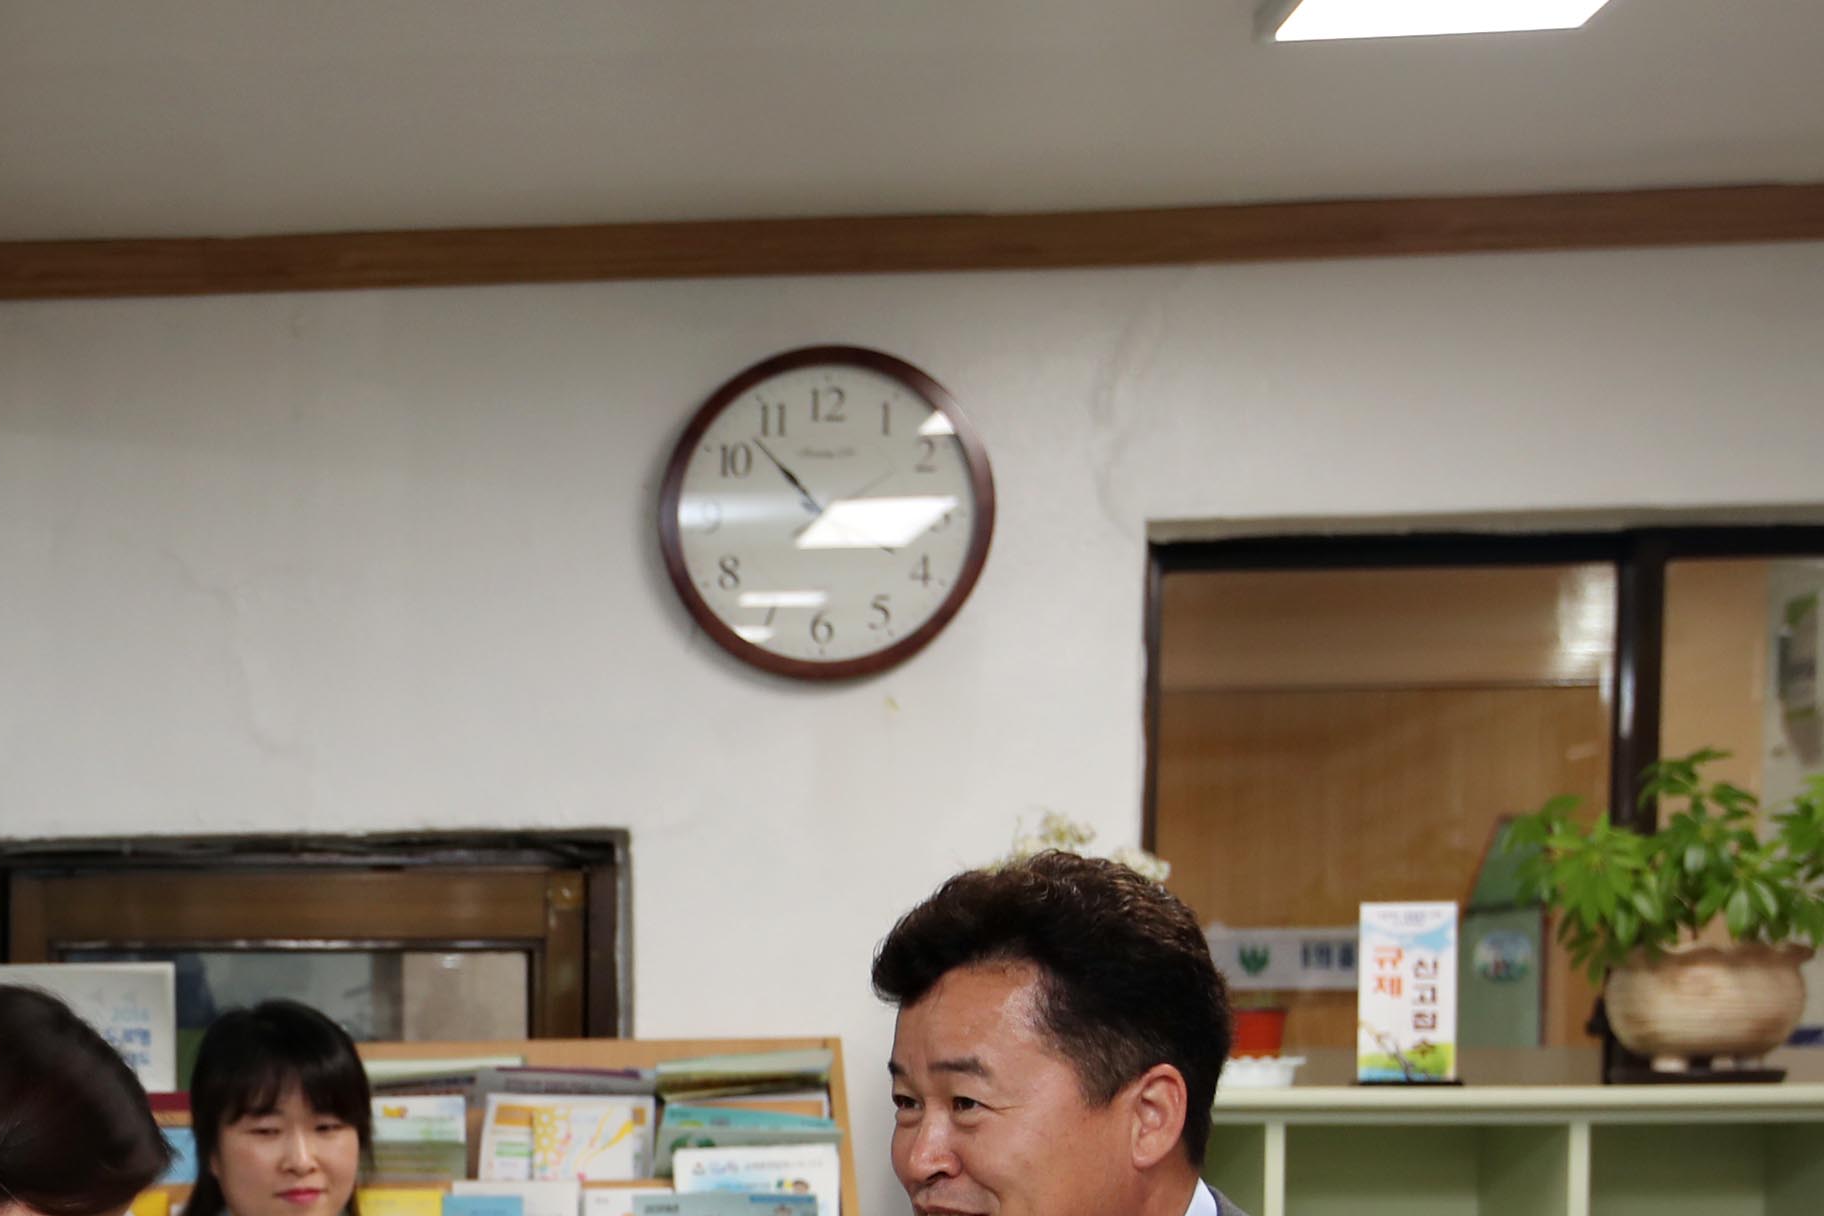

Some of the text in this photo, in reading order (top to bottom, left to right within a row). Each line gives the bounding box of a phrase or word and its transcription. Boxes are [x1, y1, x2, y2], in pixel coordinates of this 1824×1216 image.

[759, 403, 786, 437] 11
[810, 387, 845, 421] 12
[881, 402, 891, 436] 1
[720, 443, 752, 478] 10
[915, 436, 936, 473] 2
[717, 555, 741, 589] 8
[909, 555, 931, 587] 4
[810, 610, 834, 645] 6
[867, 595, 891, 631] 5
[1375, 947, 1404, 997] 규제
[1412, 957, 1440, 1057] 신고접수
